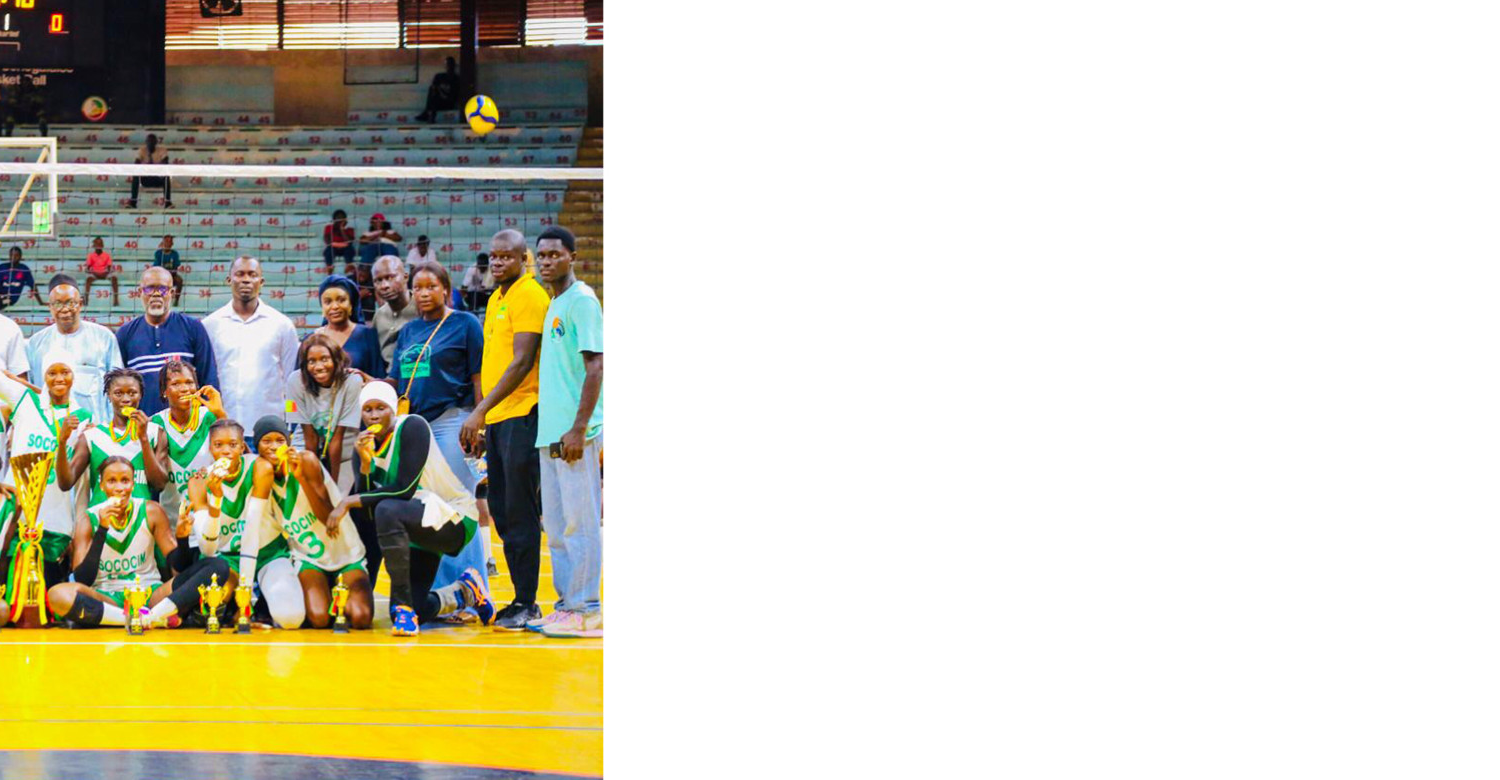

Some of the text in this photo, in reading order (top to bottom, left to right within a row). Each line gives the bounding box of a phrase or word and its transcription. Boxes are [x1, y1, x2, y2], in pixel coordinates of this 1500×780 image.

[4, 13, 10, 31] 1
[51, 14, 63, 32] 0
[124, 241, 138, 249] 40
[297, 531, 325, 558] 3
[99, 553, 146, 573] SOCOCIM
